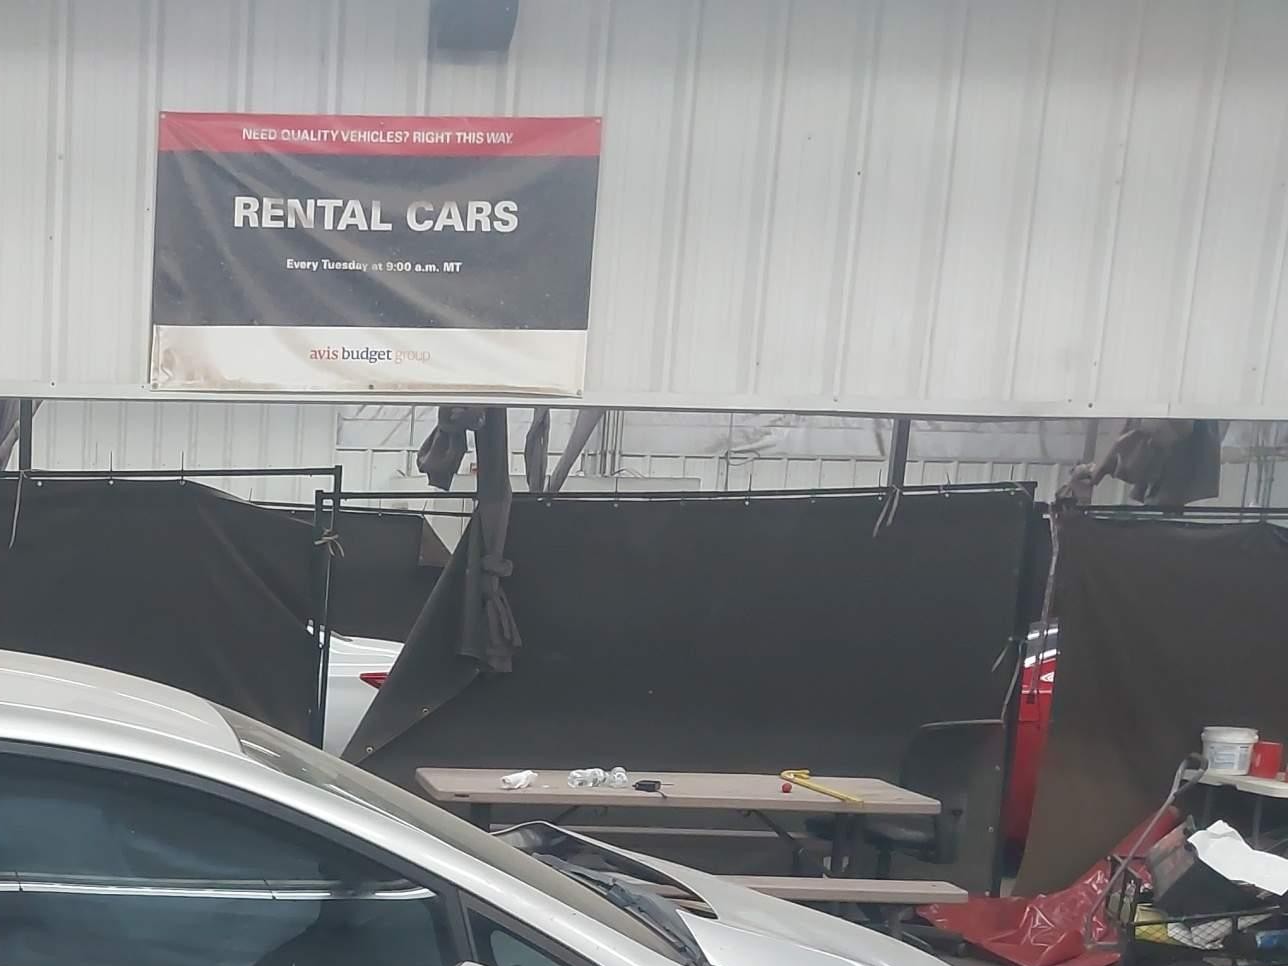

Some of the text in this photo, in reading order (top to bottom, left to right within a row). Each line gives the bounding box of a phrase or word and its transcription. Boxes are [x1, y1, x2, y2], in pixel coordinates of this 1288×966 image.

[242, 128, 277, 141] NEED
[280, 129, 339, 143] QUALITY
[340, 131, 409, 144] VEHICLES?
[412, 132, 452, 144] RIGHT
[455, 133, 484, 144] THIS
[234, 196, 519, 233] RENTAL CARS
[286, 259, 463, 274] Every Tuesday at 9:00 a.m. MT
[310, 346, 431, 364] avis budget group
